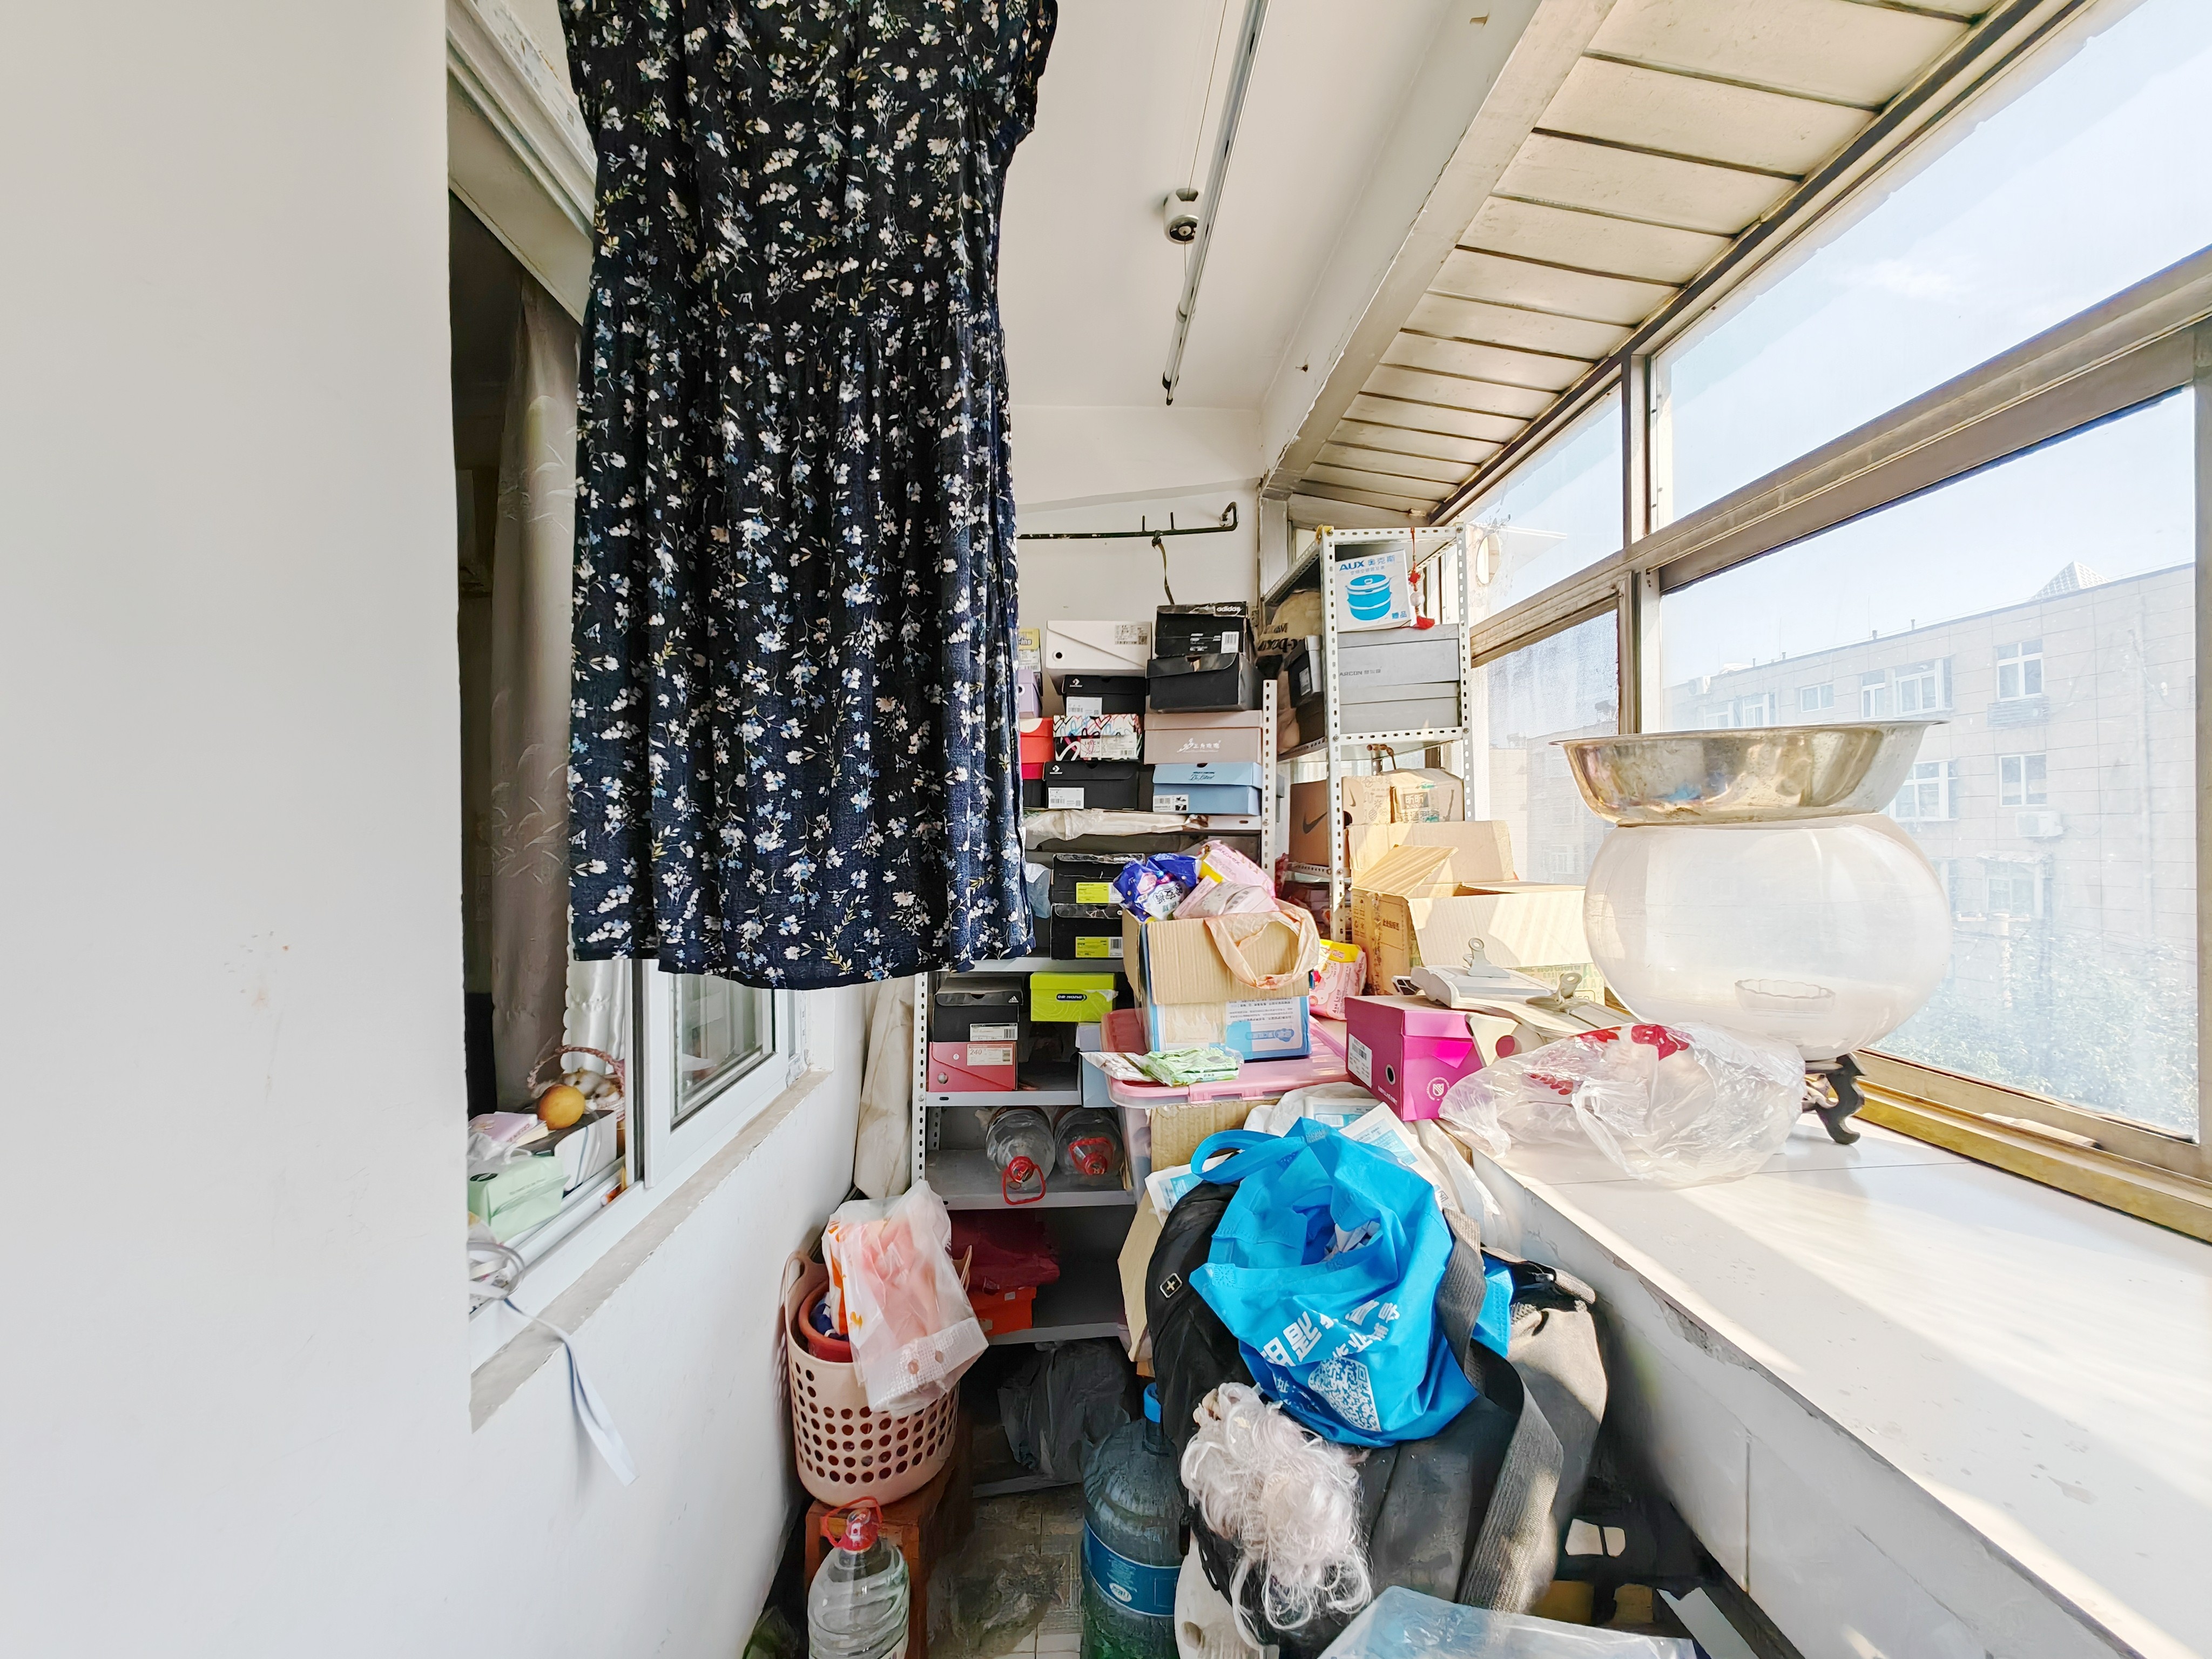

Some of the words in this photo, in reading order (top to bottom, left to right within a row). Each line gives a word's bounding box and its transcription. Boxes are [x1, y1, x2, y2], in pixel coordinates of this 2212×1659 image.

[1339, 560, 1365, 571] AUX
[1367, 555, 1395, 567] 奥克斯
